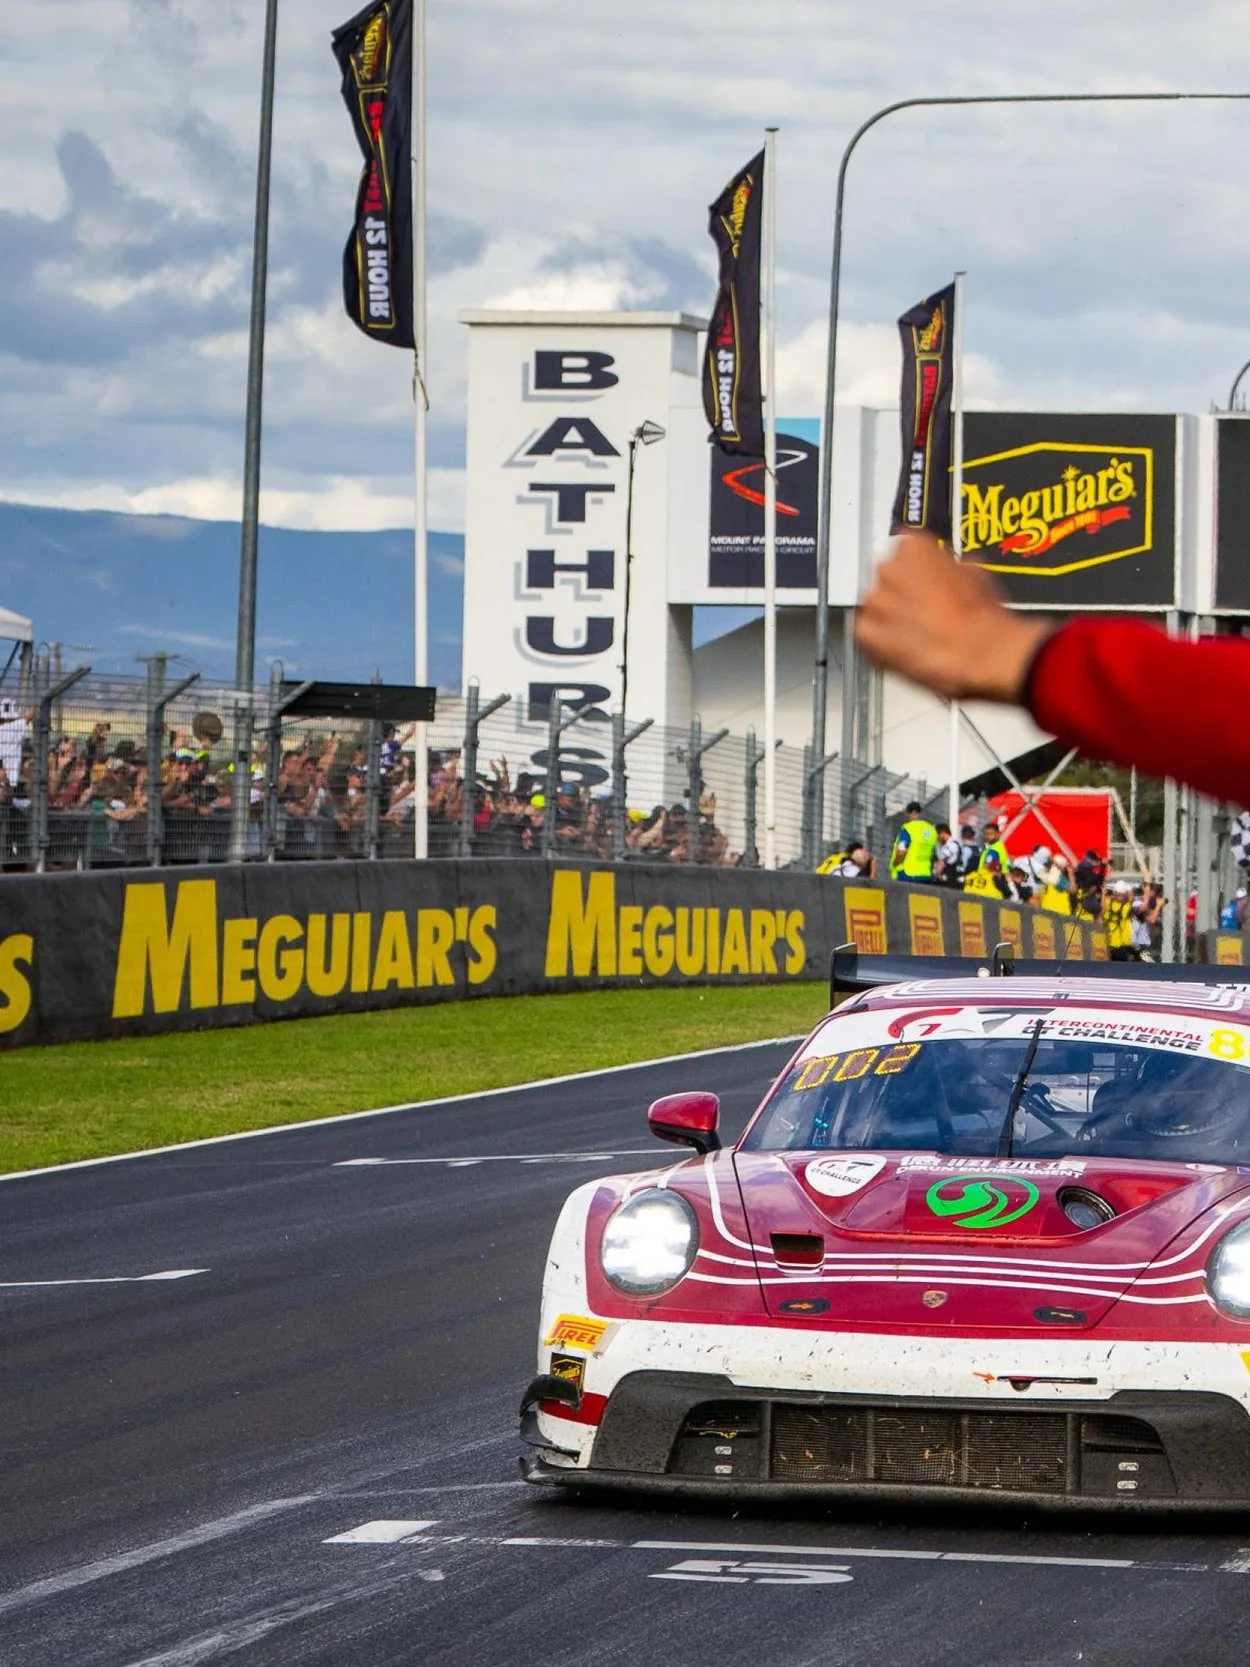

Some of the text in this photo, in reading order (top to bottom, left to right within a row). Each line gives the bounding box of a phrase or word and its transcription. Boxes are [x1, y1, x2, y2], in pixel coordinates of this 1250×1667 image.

[960, 456, 1137, 553] Meguiar's
[711, 536, 816, 546] MOUNT PAORAMA
[522, 348, 623, 789] BATHURS
[545, 869, 806, 978] MEGUIAR'S
[112, 879, 497, 1019] MEGUIAR'S
[1057, 1027, 1202, 1051] CHALLENGE
[820, 1170, 862, 1184] CHALLENGE
[958, 1166, 1083, 1179] ENVIRONMENT
[551, 1320, 607, 1346] PIREL
